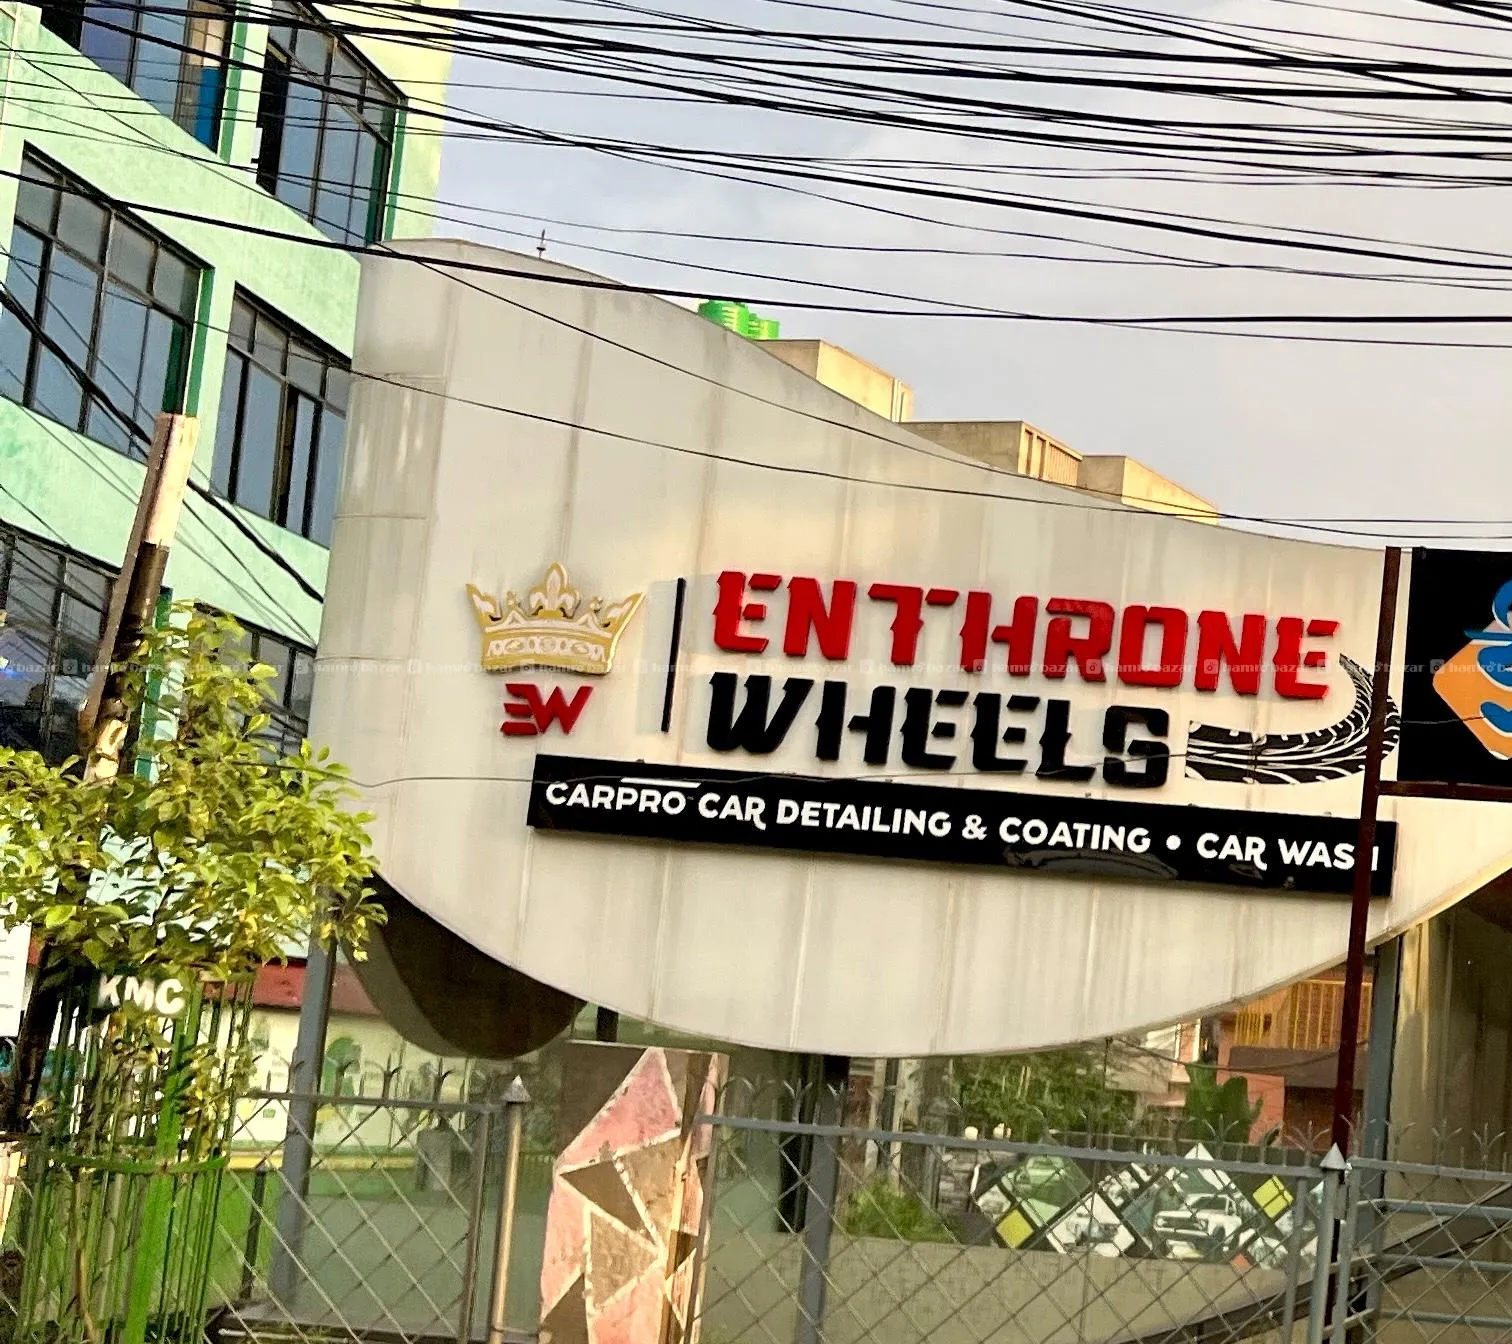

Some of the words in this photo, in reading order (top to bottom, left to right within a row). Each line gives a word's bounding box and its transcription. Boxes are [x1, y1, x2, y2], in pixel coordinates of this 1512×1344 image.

[713, 570, 1338, 699] ENTHRONE
[706, 672, 1170, 787] WHEELS
[546, 781, 686, 815] CARPRO
[698, 792, 766, 830] CAR
[776, 799, 951, 837] DETAILING
[961, 814, 988, 840] &
[999, 817, 1151, 854] COATING
[1196, 832, 1268, 871] CAR
[1278, 838, 1380, 871] WAS
[98, 974, 186, 1015] KMC
